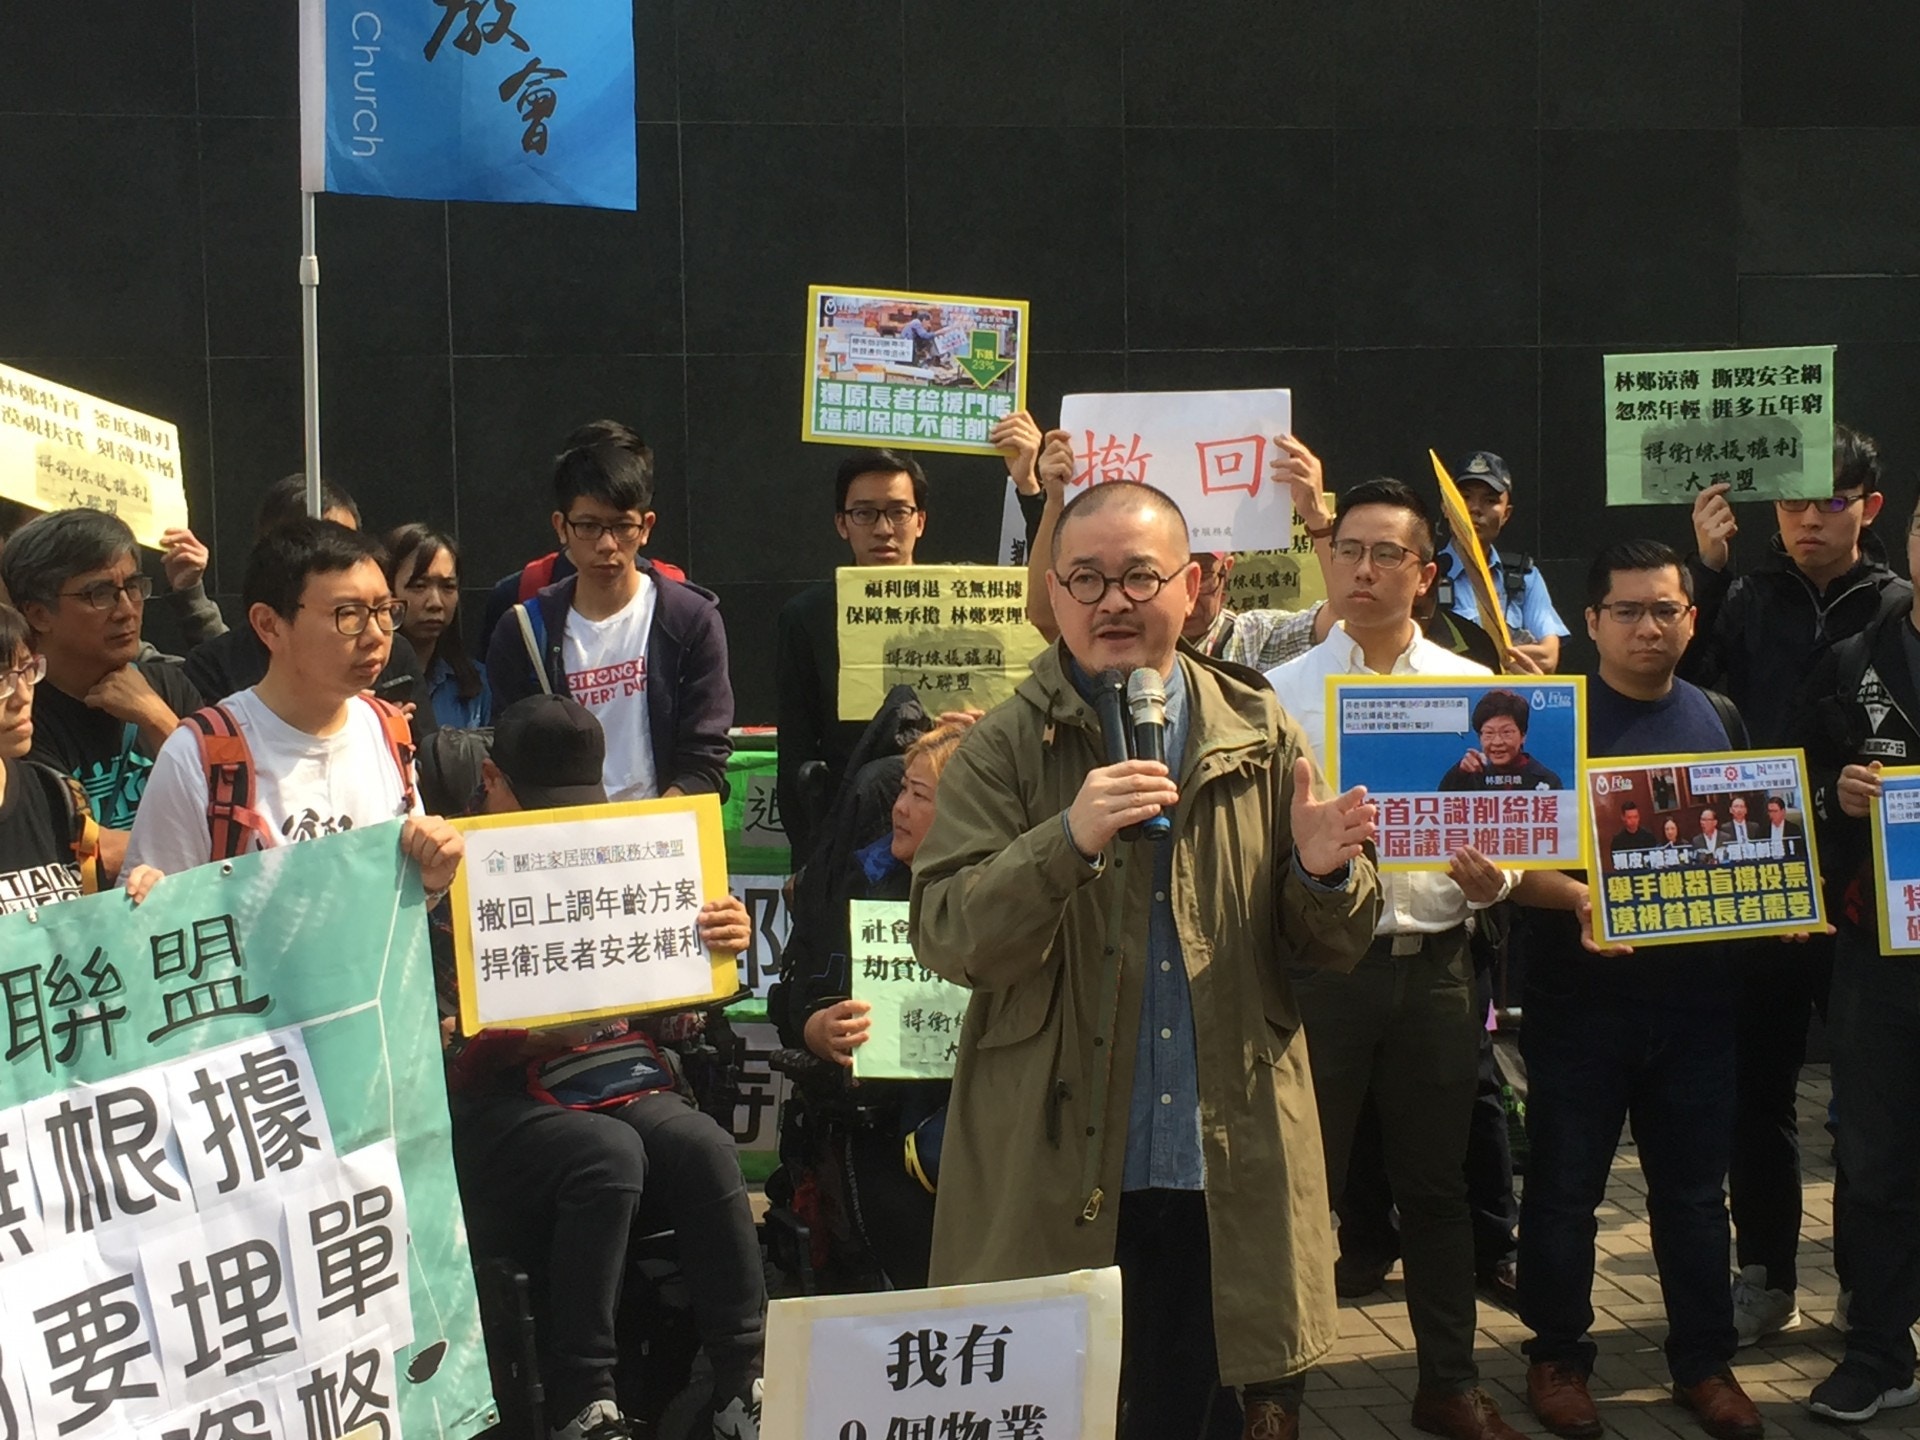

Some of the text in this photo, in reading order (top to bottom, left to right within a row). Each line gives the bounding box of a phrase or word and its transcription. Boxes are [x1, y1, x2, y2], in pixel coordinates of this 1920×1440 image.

[352, 11, 384, 157] Church
[1615, 363, 1822, 392] 林鄭涼薄 撕毀安全網
[819, 382, 1012, 417] 還原長者綜援門檻
[1615, 394, 1823, 421] 忽然年輕 捱多五年窮
[819, 408, 1000, 441] 福利保障不能削
[1195, 434, 1266, 497] 回
[865, 579, 1022, 598] 福利倒退 毫無根據
[846, 606, 1029, 625] 保障無承擔 林鄭要埋
[573, 687, 617, 707] VERY
[1607, 861, 1809, 903] 舉手機器盲撐投票
[477, 878, 698, 932] 撤回上調年齡方案
[1610, 891, 1812, 935] 漠視貧窮長者需要
[480, 924, 701, 982] 捍衛長者安老權利
[0, 913, 271, 1073] 聯盟
[0, 1185, 400, 1440] 要埋單
[886, 1324, 1013, 1391] 我有
